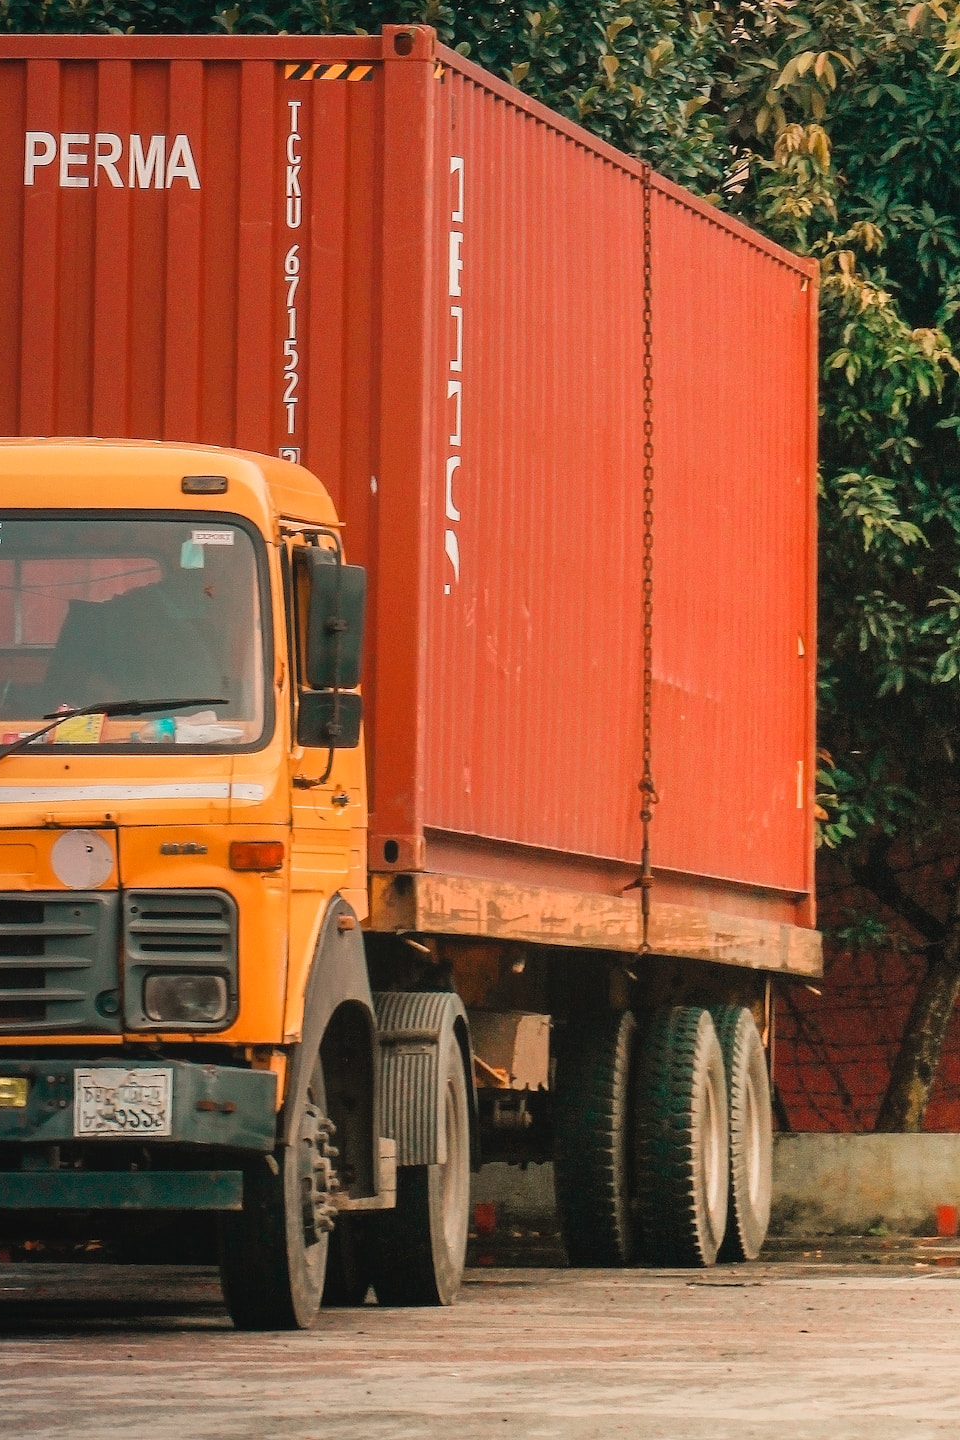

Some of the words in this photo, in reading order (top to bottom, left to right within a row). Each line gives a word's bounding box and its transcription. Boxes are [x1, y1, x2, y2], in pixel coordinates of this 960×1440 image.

[23, 131, 201, 190] PERMA
[285, 100, 302, 229] TCKU
[283, 245, 301, 435] 671521
